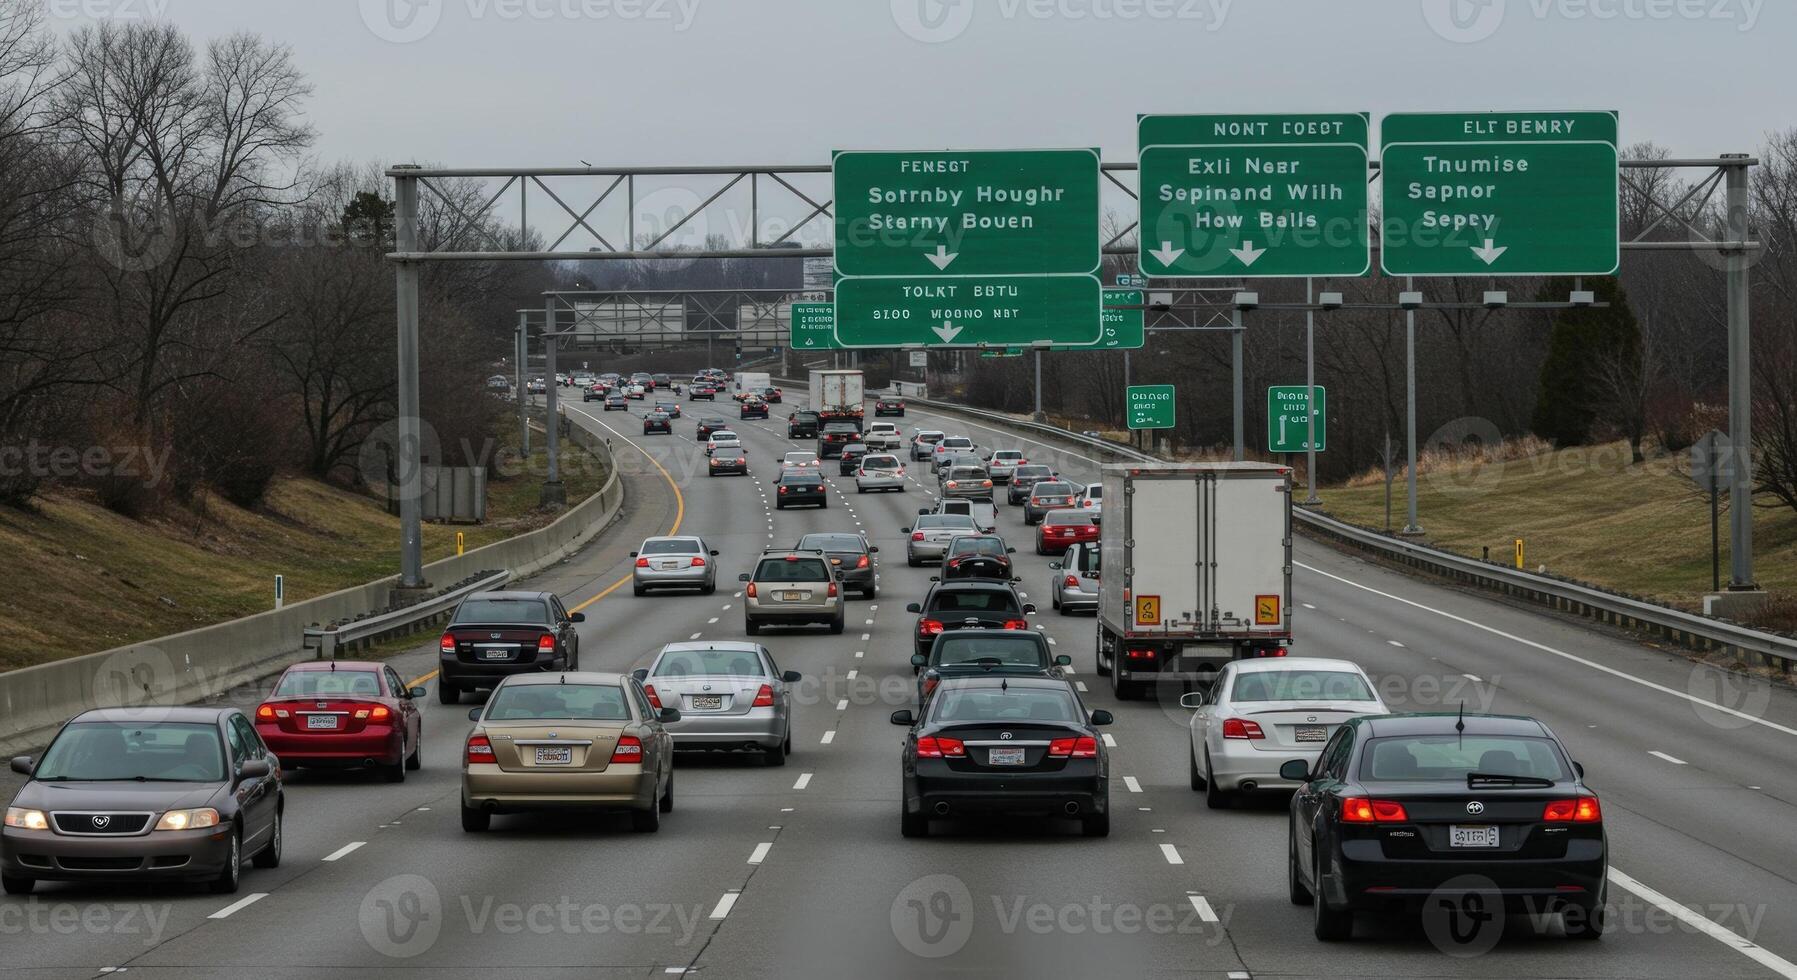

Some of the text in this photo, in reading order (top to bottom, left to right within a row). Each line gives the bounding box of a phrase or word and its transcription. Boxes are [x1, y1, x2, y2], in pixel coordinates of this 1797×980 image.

[1214, 122, 1269, 136] NONT
[1422, 155, 1529, 173] Tnumise
[977, 185, 1065, 206] Houghr
[1407, 182, 1496, 202] Sapnor
[962, 212, 1033, 229] Bouen
[1195, 211, 1243, 228] How
